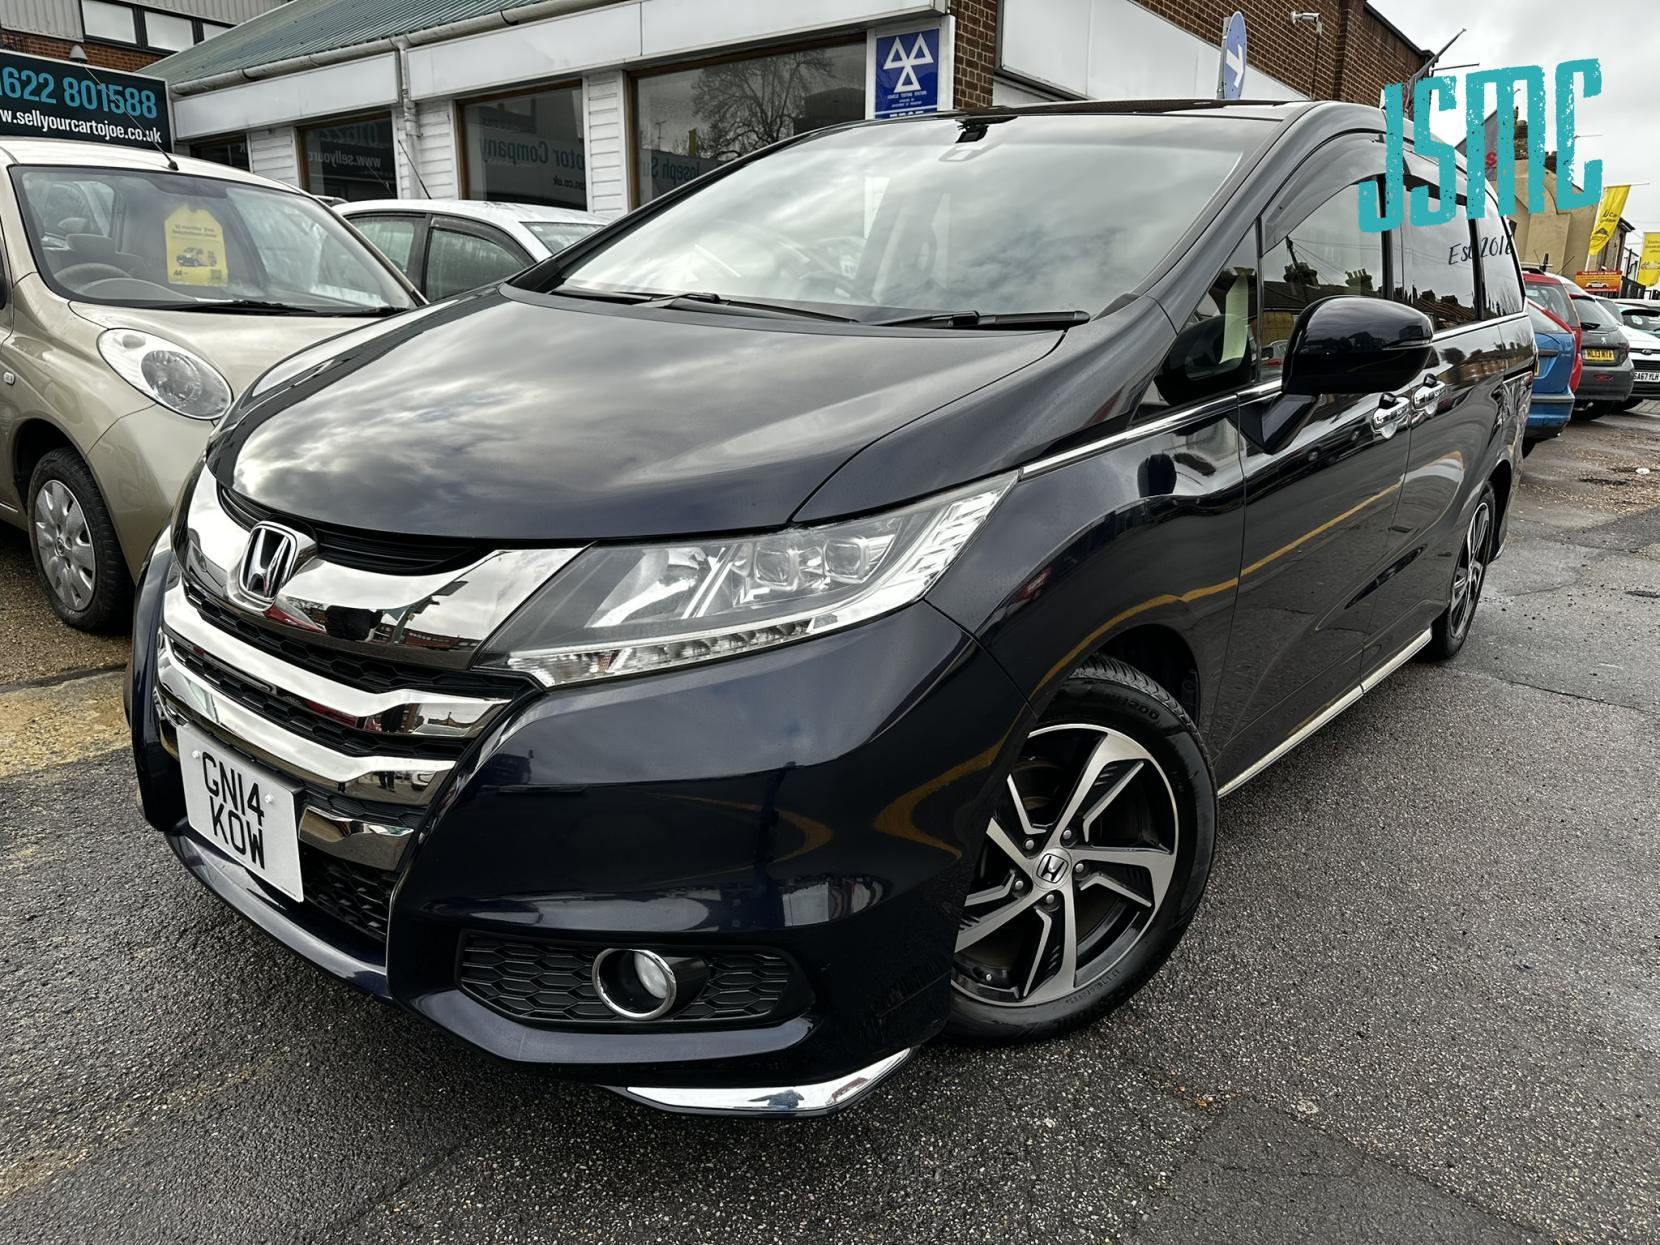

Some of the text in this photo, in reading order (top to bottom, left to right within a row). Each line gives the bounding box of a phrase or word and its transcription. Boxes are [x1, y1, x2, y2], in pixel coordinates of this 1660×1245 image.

[0, 66, 157, 119] 622 801588
[1632, 372, 1648, 380] SA67
[202, 751, 265, 827] GN14
[209, 795, 265, 870] KOW
